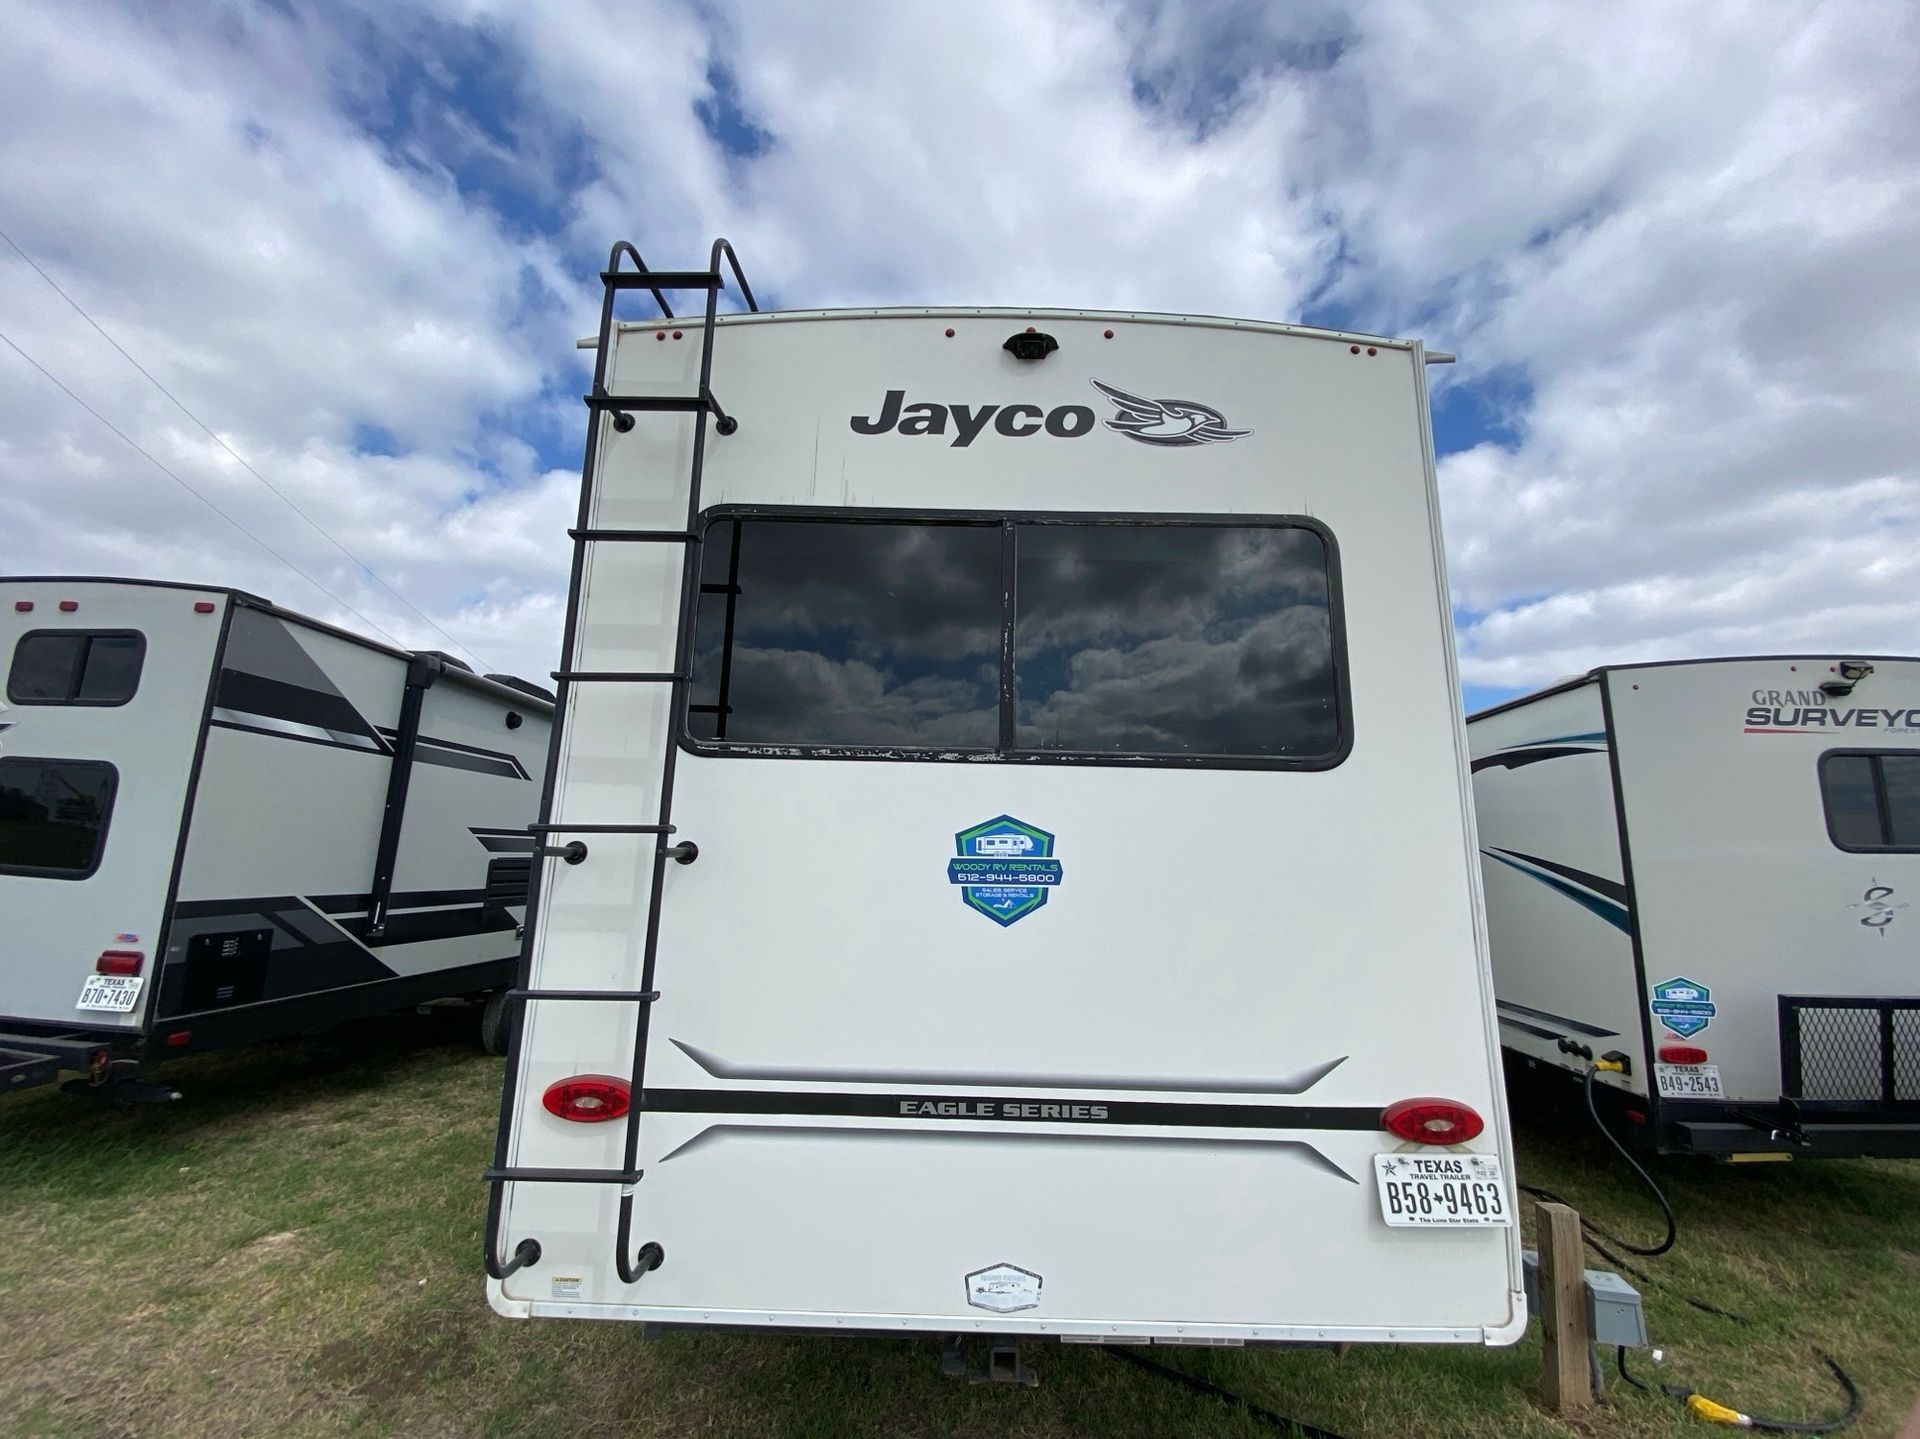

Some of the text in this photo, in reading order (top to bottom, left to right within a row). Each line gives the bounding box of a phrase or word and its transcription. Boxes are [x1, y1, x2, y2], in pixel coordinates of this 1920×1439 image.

[850, 390, 1095, 447] Jayco
[1752, 690, 1826, 707] GRAND
[953, 863, 1058, 872] WOODY RV RENTALS
[900, 1101, 1109, 1119] EAGLE SERIES
[1413, 1160, 1463, 1173] TEXAS
